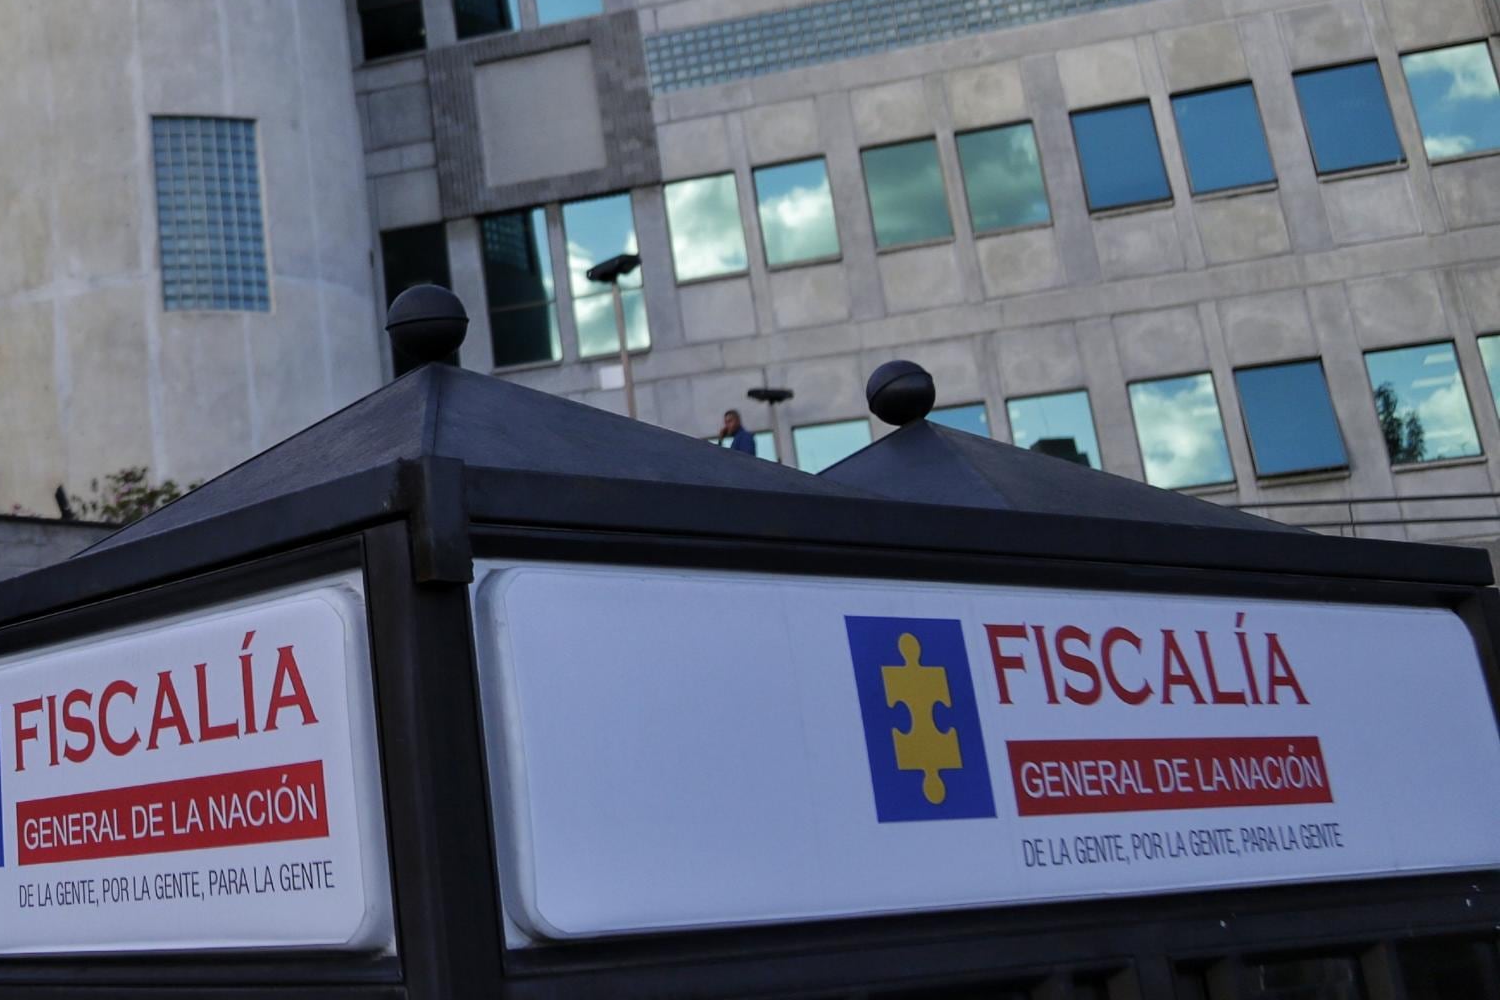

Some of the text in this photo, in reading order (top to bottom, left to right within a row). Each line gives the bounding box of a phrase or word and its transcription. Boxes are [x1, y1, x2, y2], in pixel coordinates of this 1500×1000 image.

[983, 612, 1311, 706] FISCALÍA
[13, 630, 319, 771] FISCALÍA
[1021, 744, 1323, 798] GENERAL DE LA NACIÓN
[23, 774, 317, 850] GENERAL DE LA NACIÓN
[1022, 823, 1344, 867] DE LA GENTE, POR LA GENTE, PARA LA GENTE
[19, 860, 335, 908] DE LA GENTE, POR LA GENTE, PARA LA GENTE
